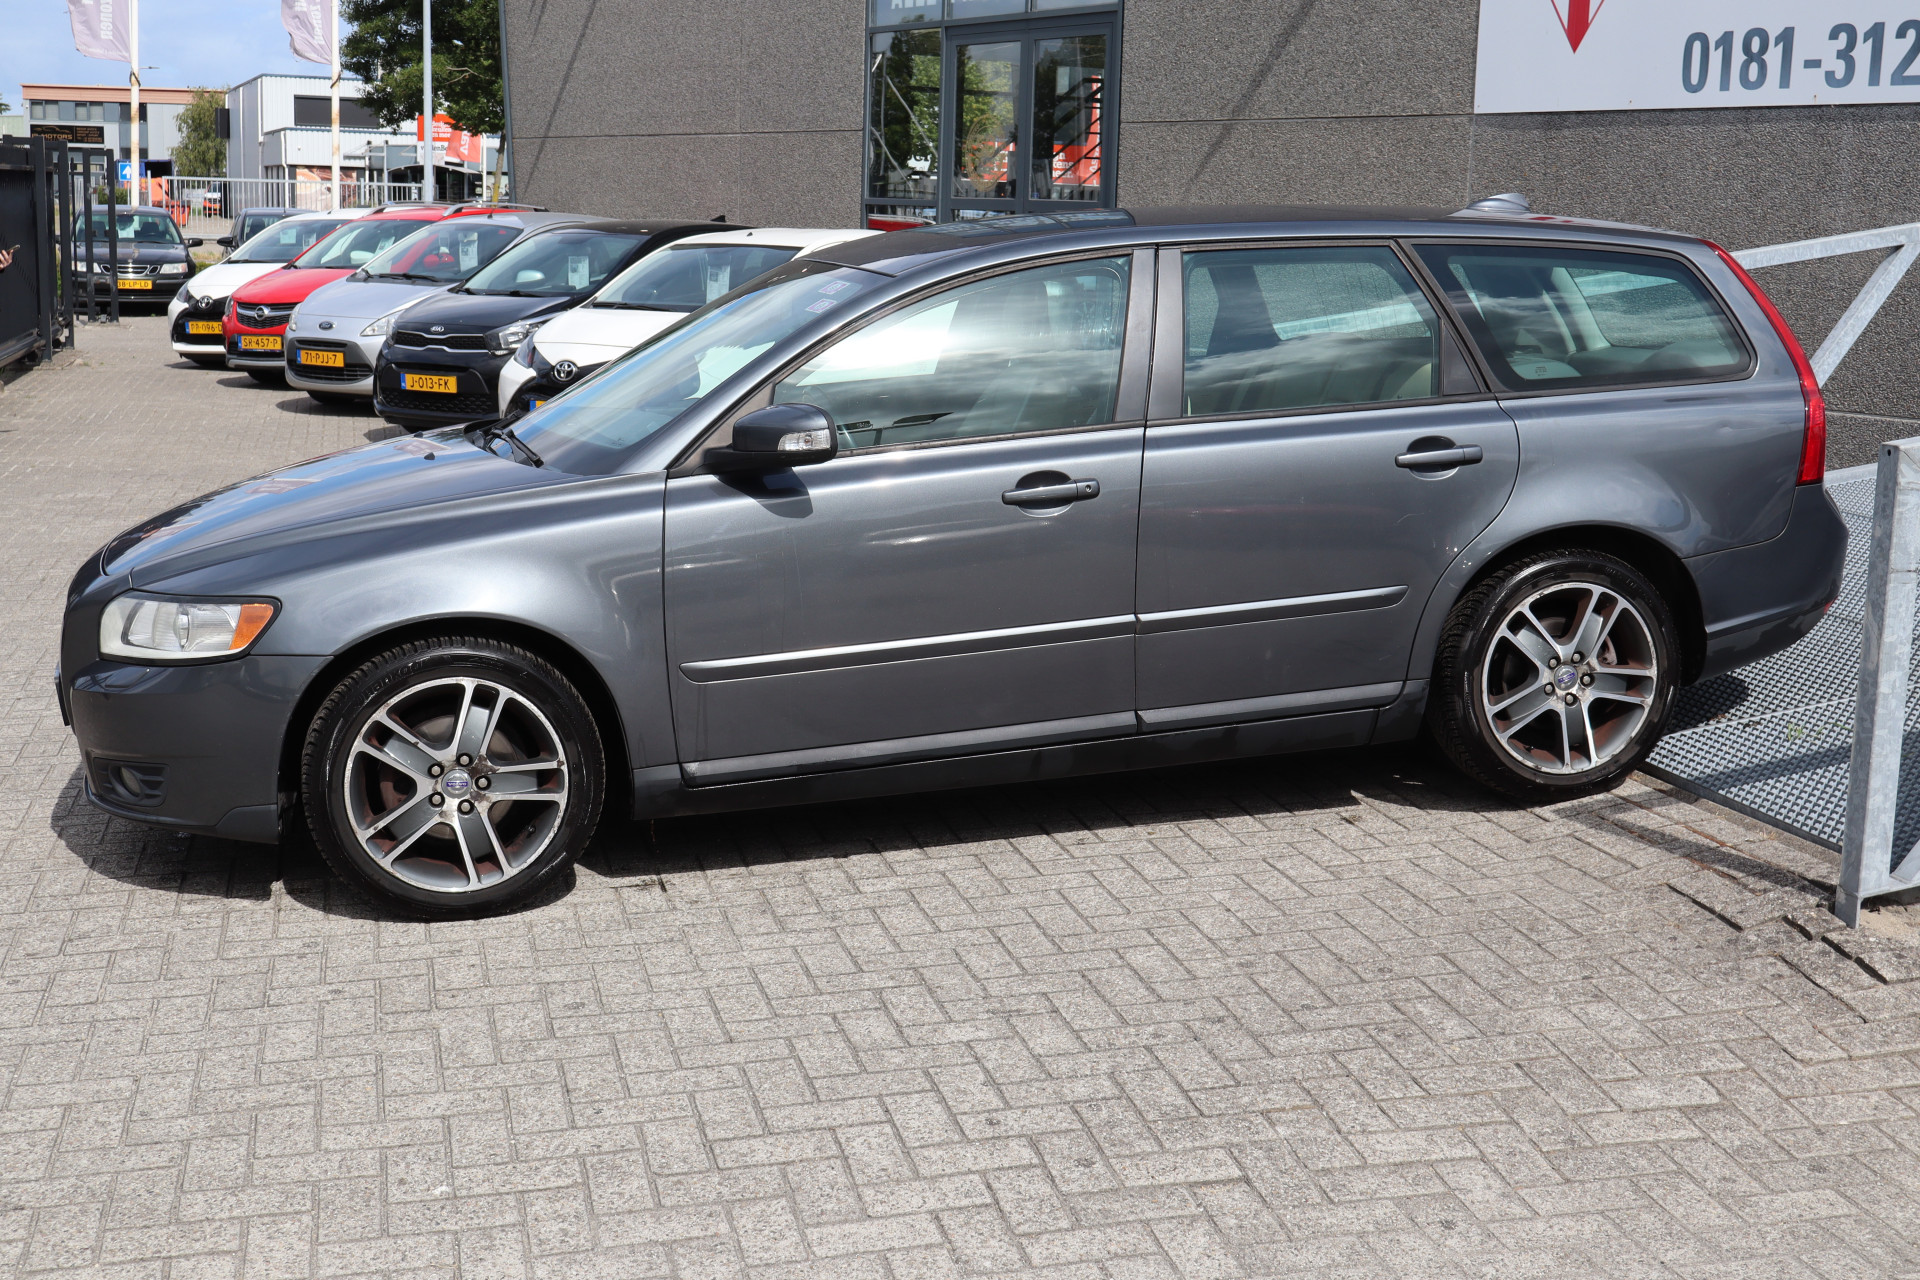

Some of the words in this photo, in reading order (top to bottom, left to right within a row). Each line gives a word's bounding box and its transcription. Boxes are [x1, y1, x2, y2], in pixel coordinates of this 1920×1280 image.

[1682, 19, 1920, 94] 0181-312
[243, 337, 278, 347] SR-457-P
[304, 352, 338, 365] 71-PJJ-7
[410, 376, 450, 390] J-013-FK
